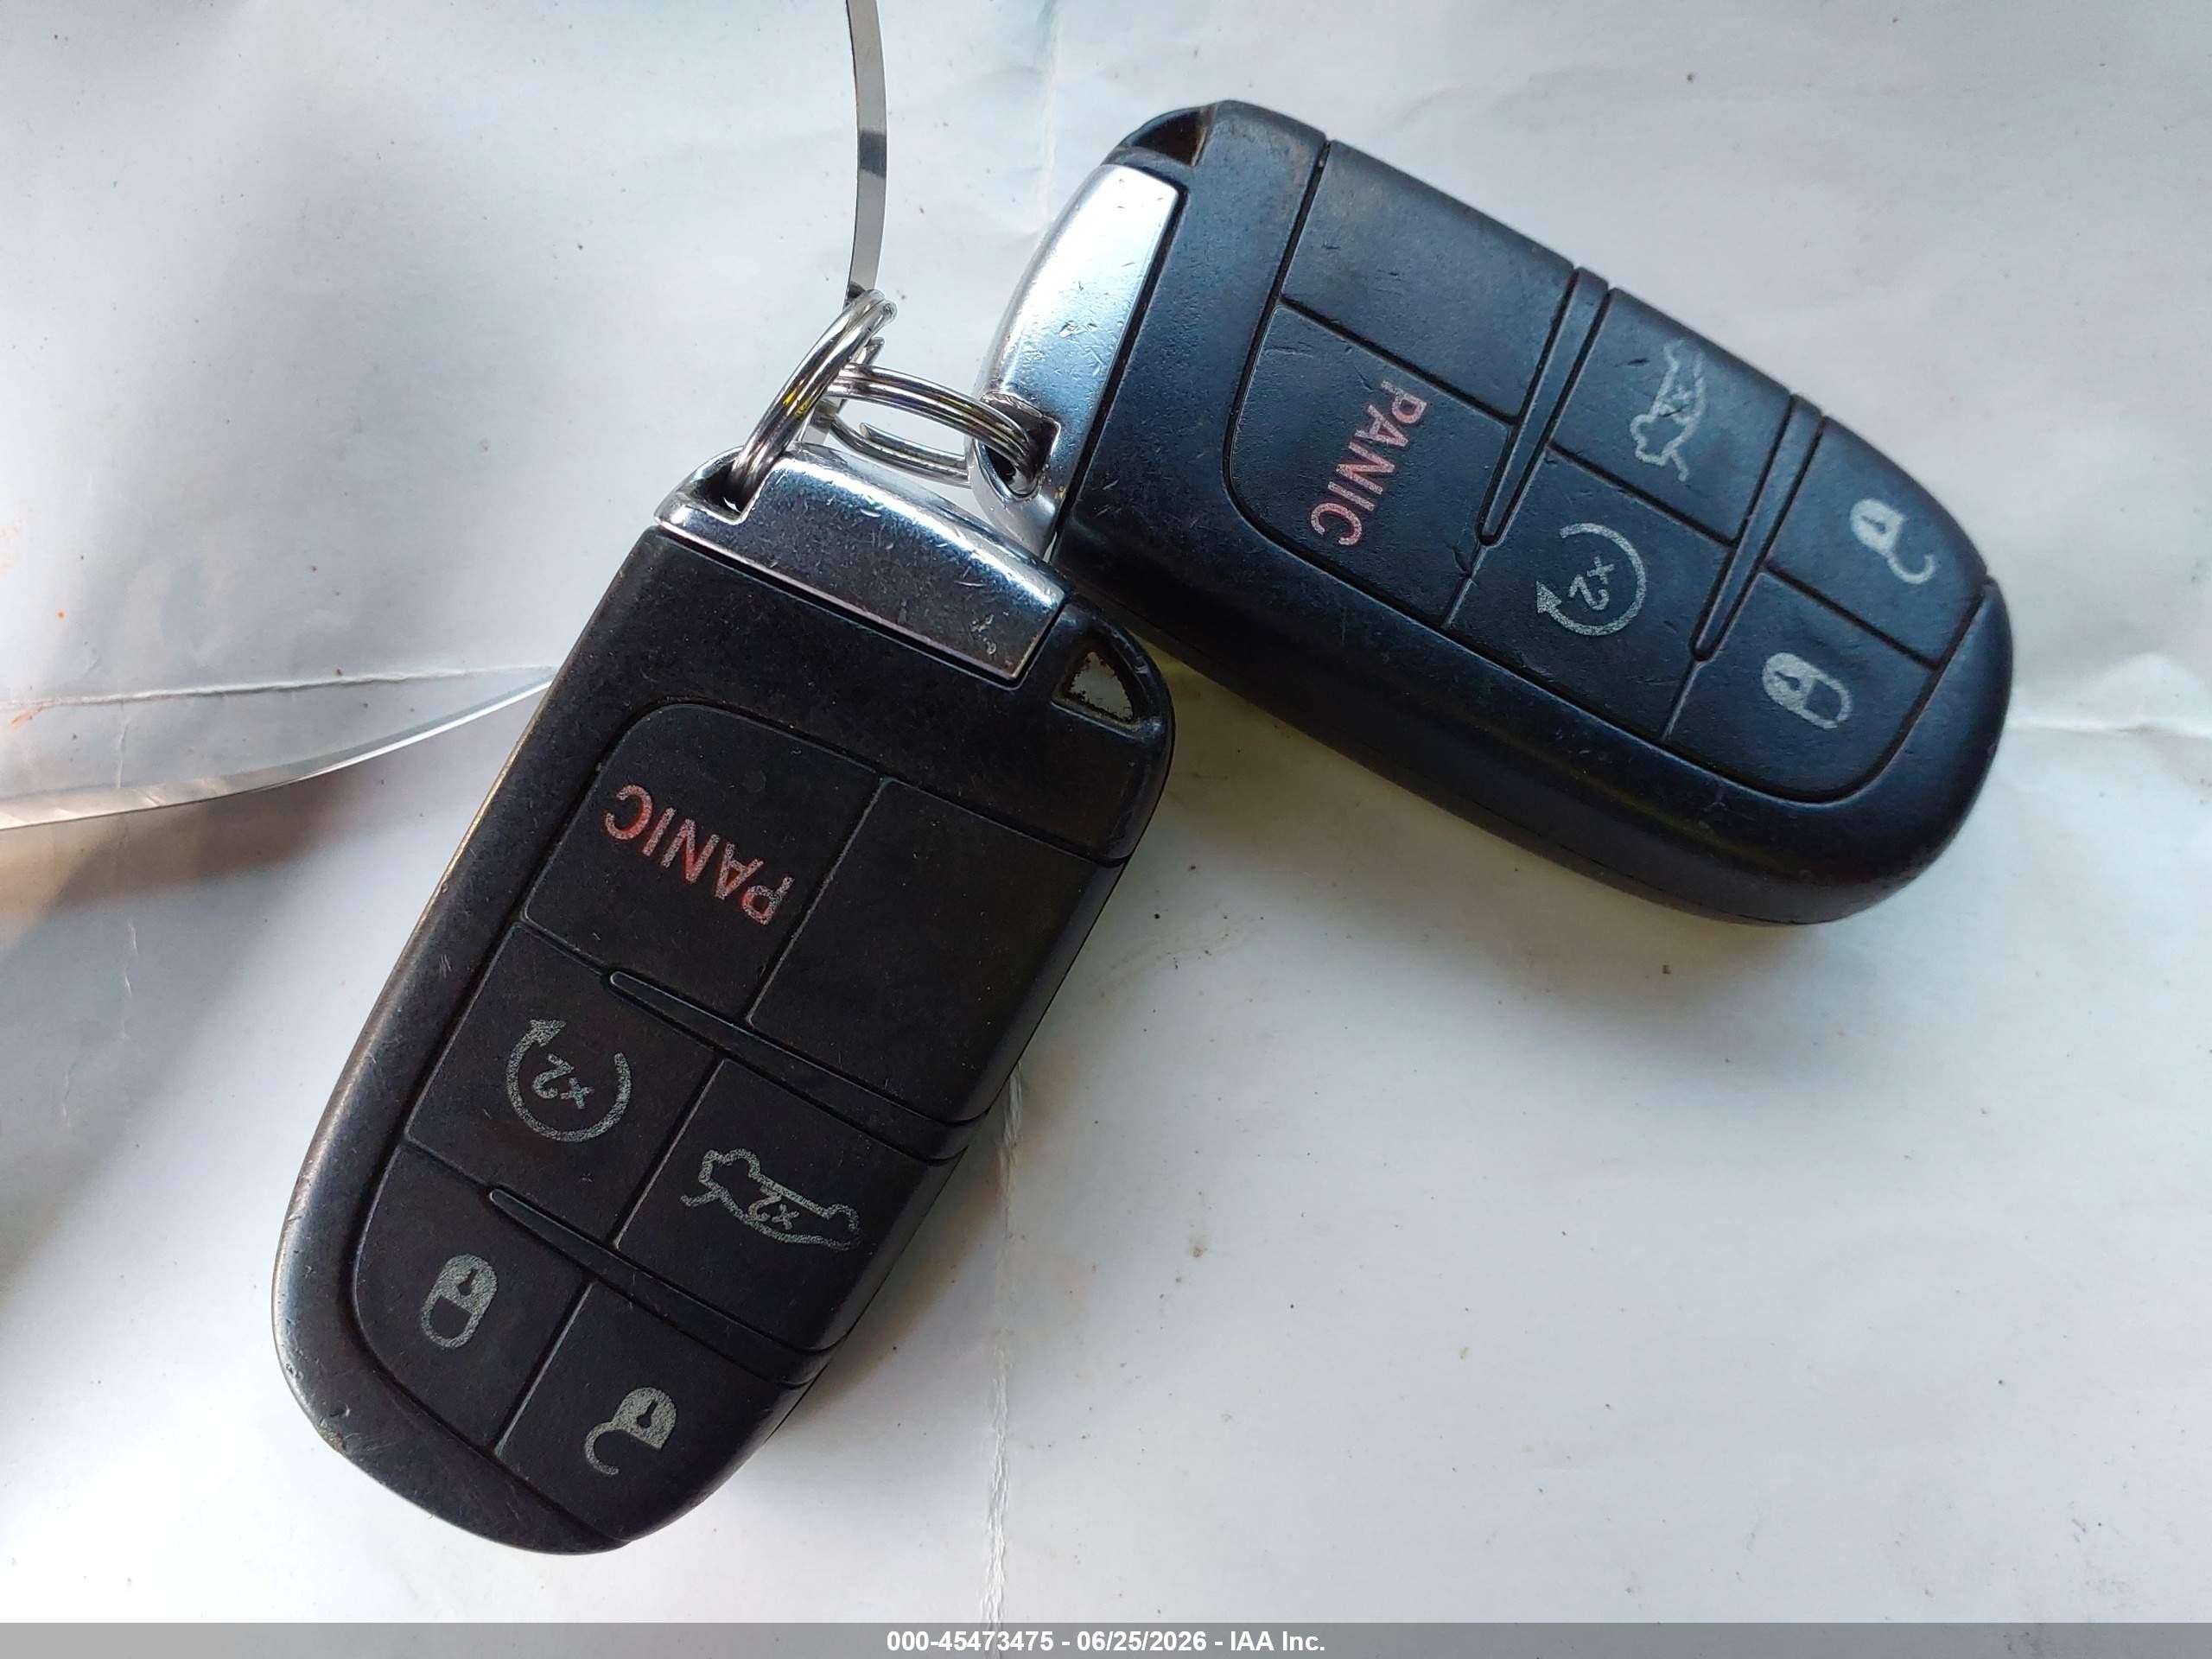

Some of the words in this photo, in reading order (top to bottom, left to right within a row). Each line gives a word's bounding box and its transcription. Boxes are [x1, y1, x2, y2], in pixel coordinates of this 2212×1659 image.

[1309, 380, 1428, 547] PANIC
[1568, 556, 1616, 611] x2
[605, 783, 796, 925] PANIC
[531, 1053, 594, 1109] x2
